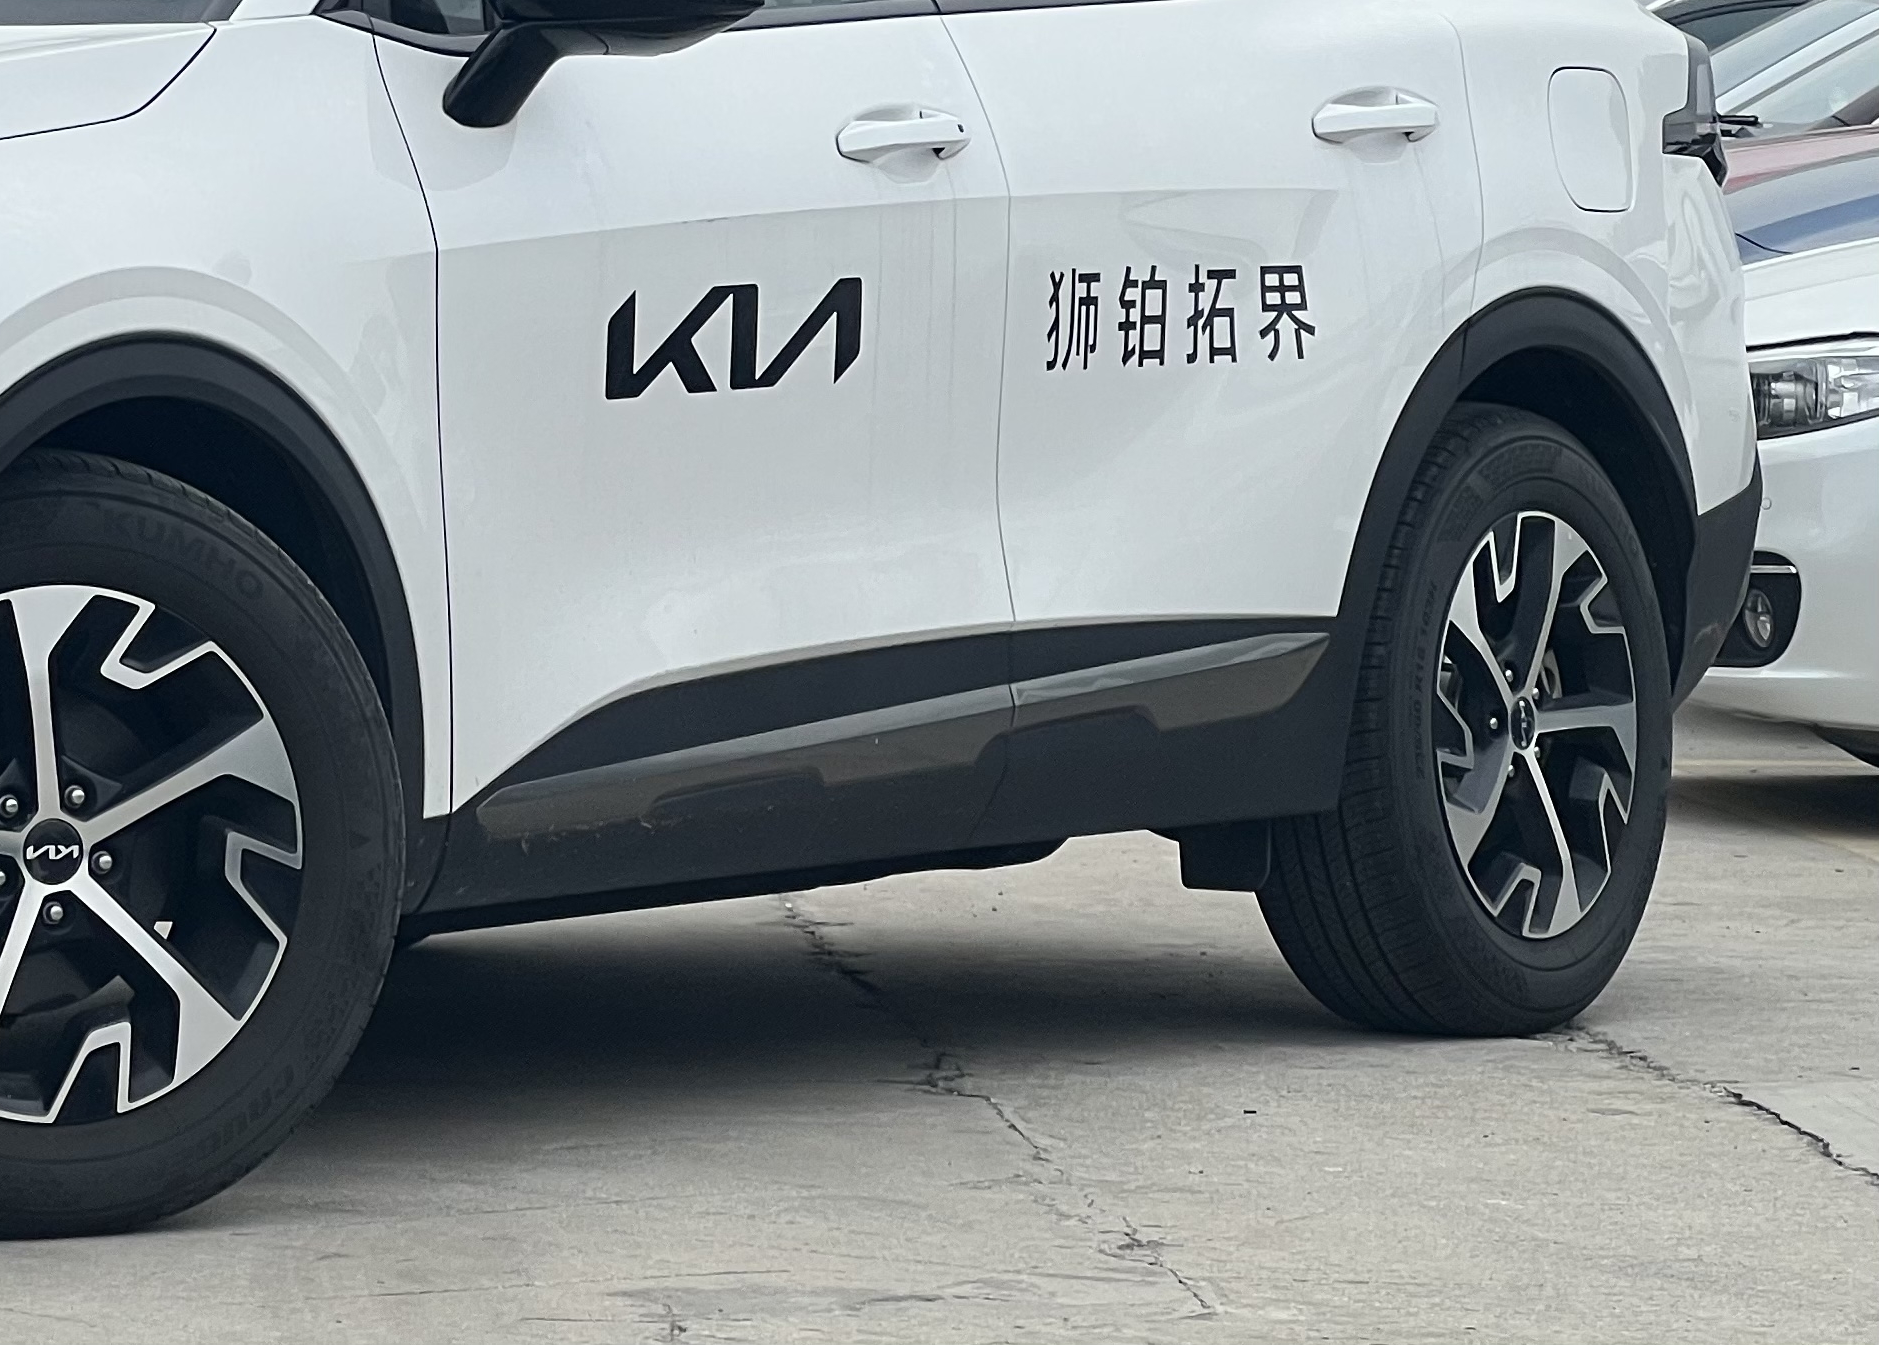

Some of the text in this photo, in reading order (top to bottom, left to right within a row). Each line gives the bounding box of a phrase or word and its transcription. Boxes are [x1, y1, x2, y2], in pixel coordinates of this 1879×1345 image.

[605, 276, 863, 400] KIA
[1045, 263, 1317, 372] 狮铂拓界
